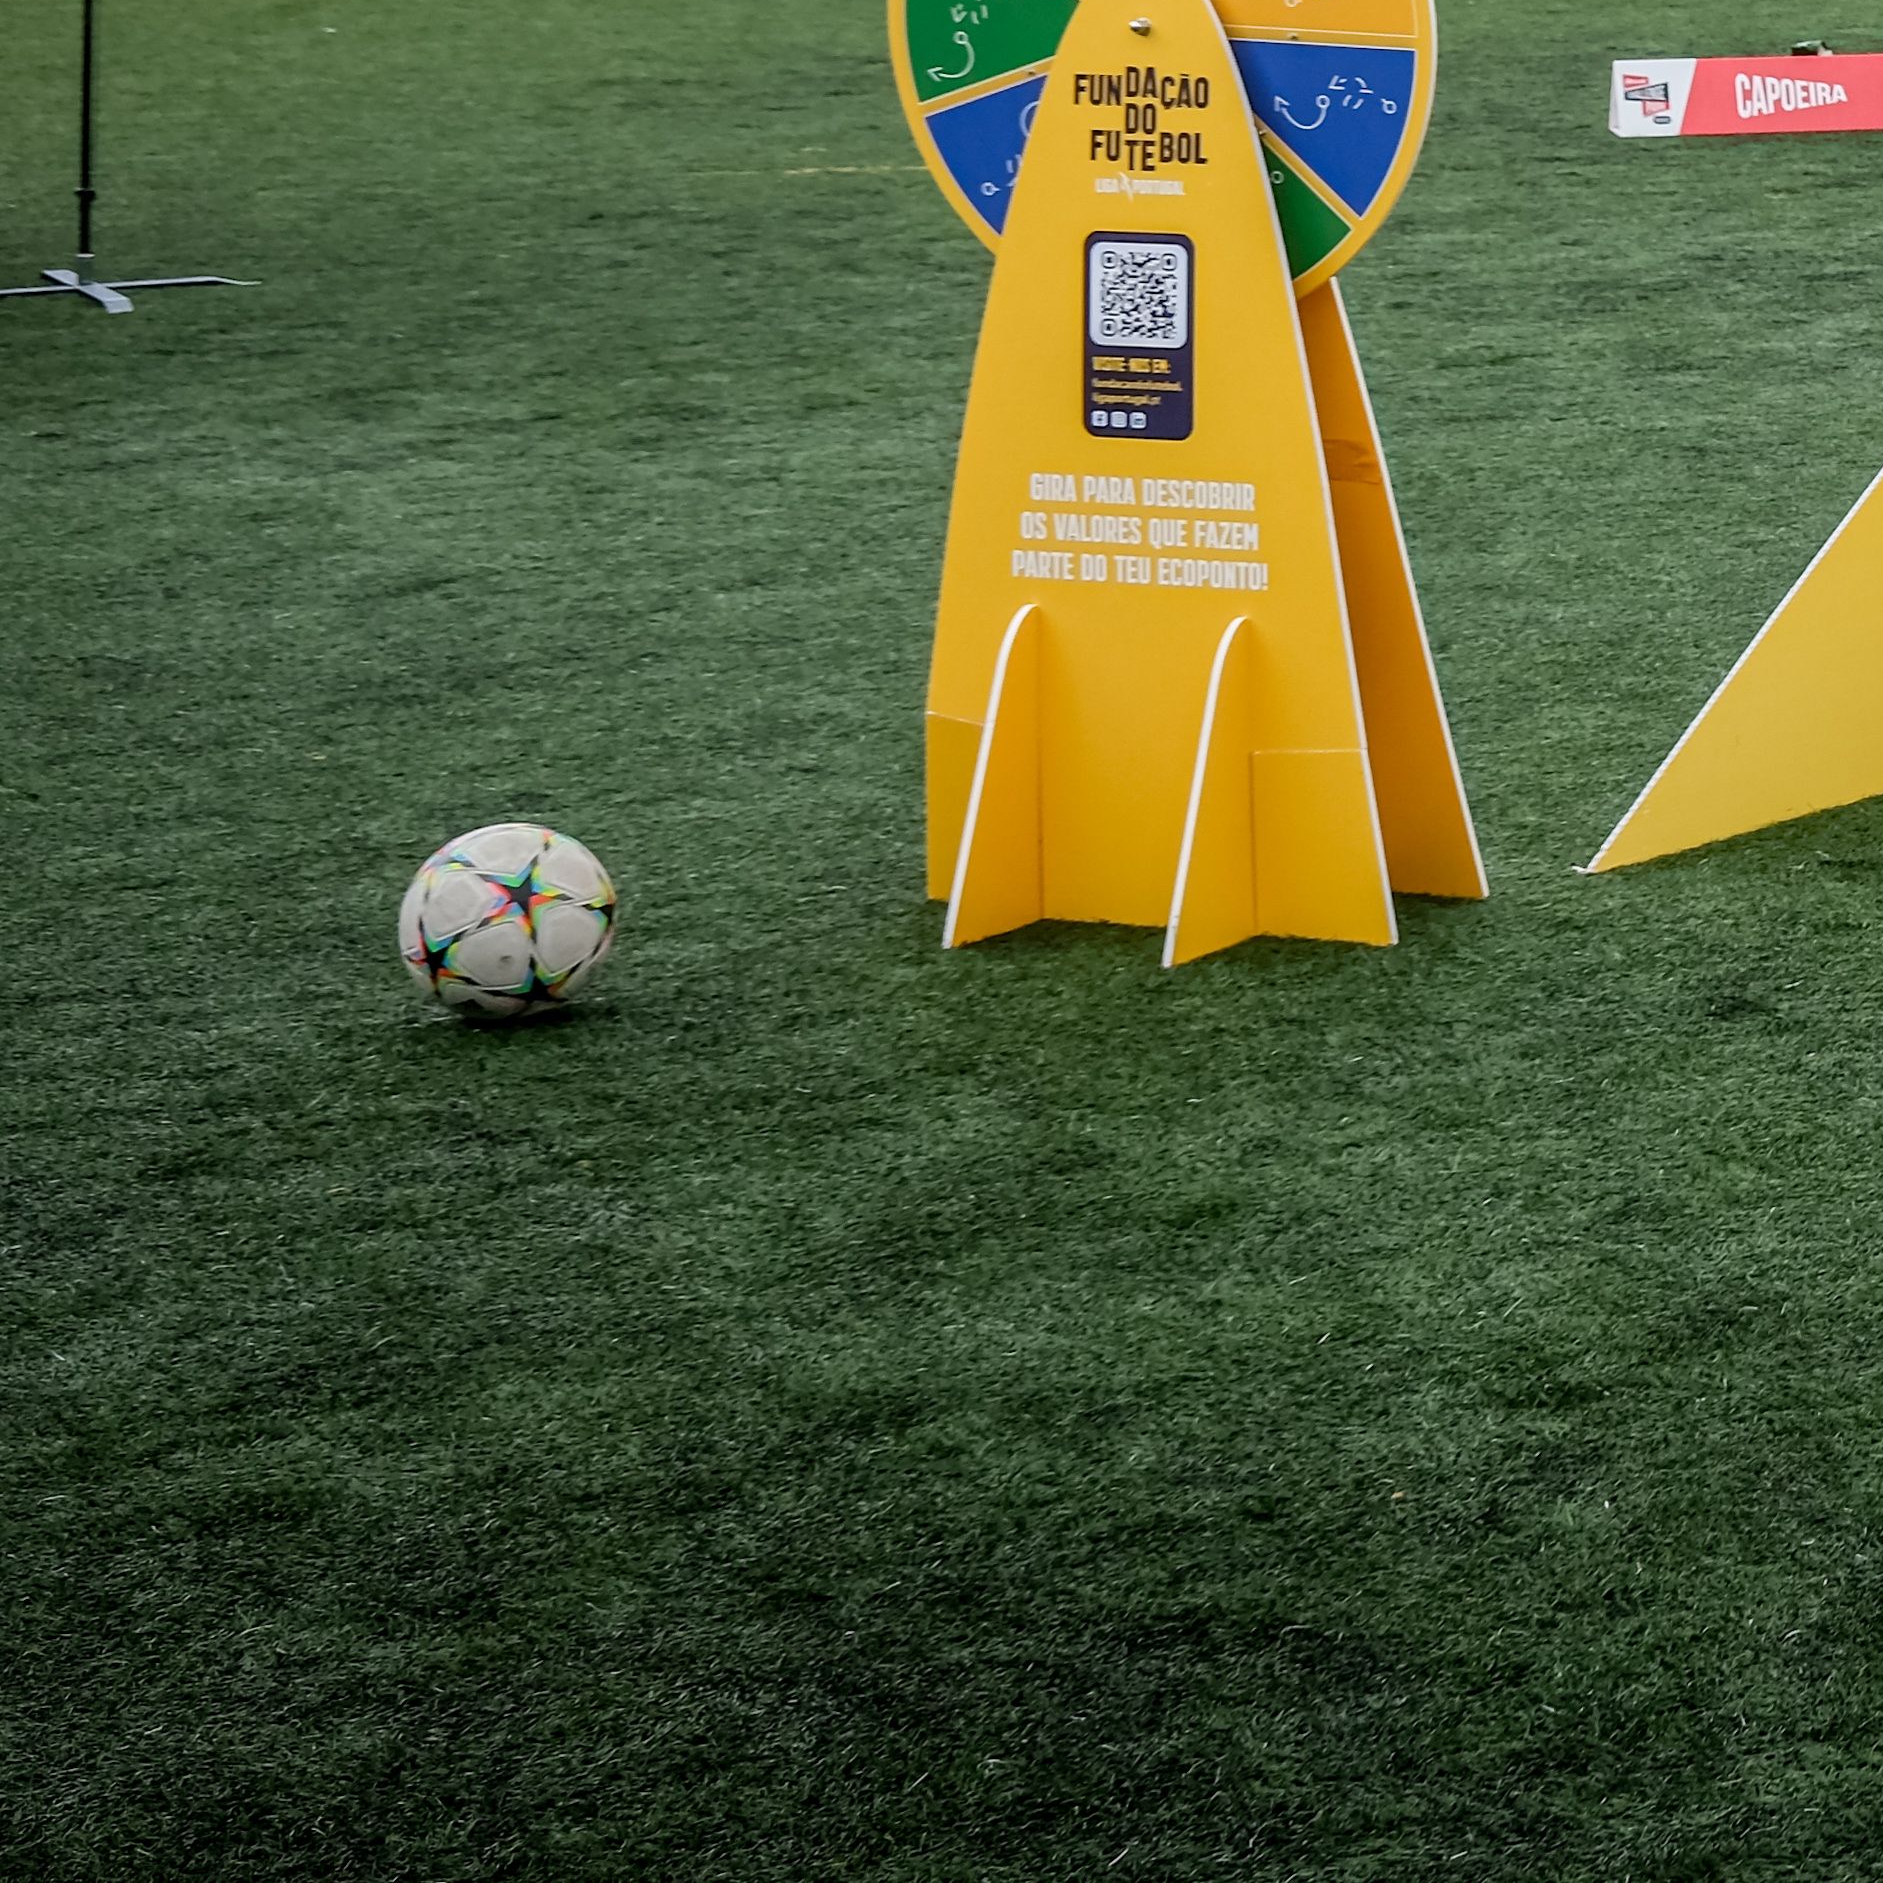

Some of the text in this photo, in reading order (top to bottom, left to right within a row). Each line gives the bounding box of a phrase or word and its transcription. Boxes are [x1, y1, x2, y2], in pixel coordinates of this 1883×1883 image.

[1073, 66, 1209, 109] FUNDAÇÃO
[1734, 73, 1848, 119] CAPOEIRA
[1124, 103, 1156, 134] DO
[1090, 129, 1208, 171] FUTEBOL
[1030, 473, 1256, 511] GIRA PARA DESCOBRIR
[1020, 511, 1259, 551] OS VALORES QUE FAZEM
[1011, 550, 1269, 591] PARTE DO TEU ECOPONTO!
